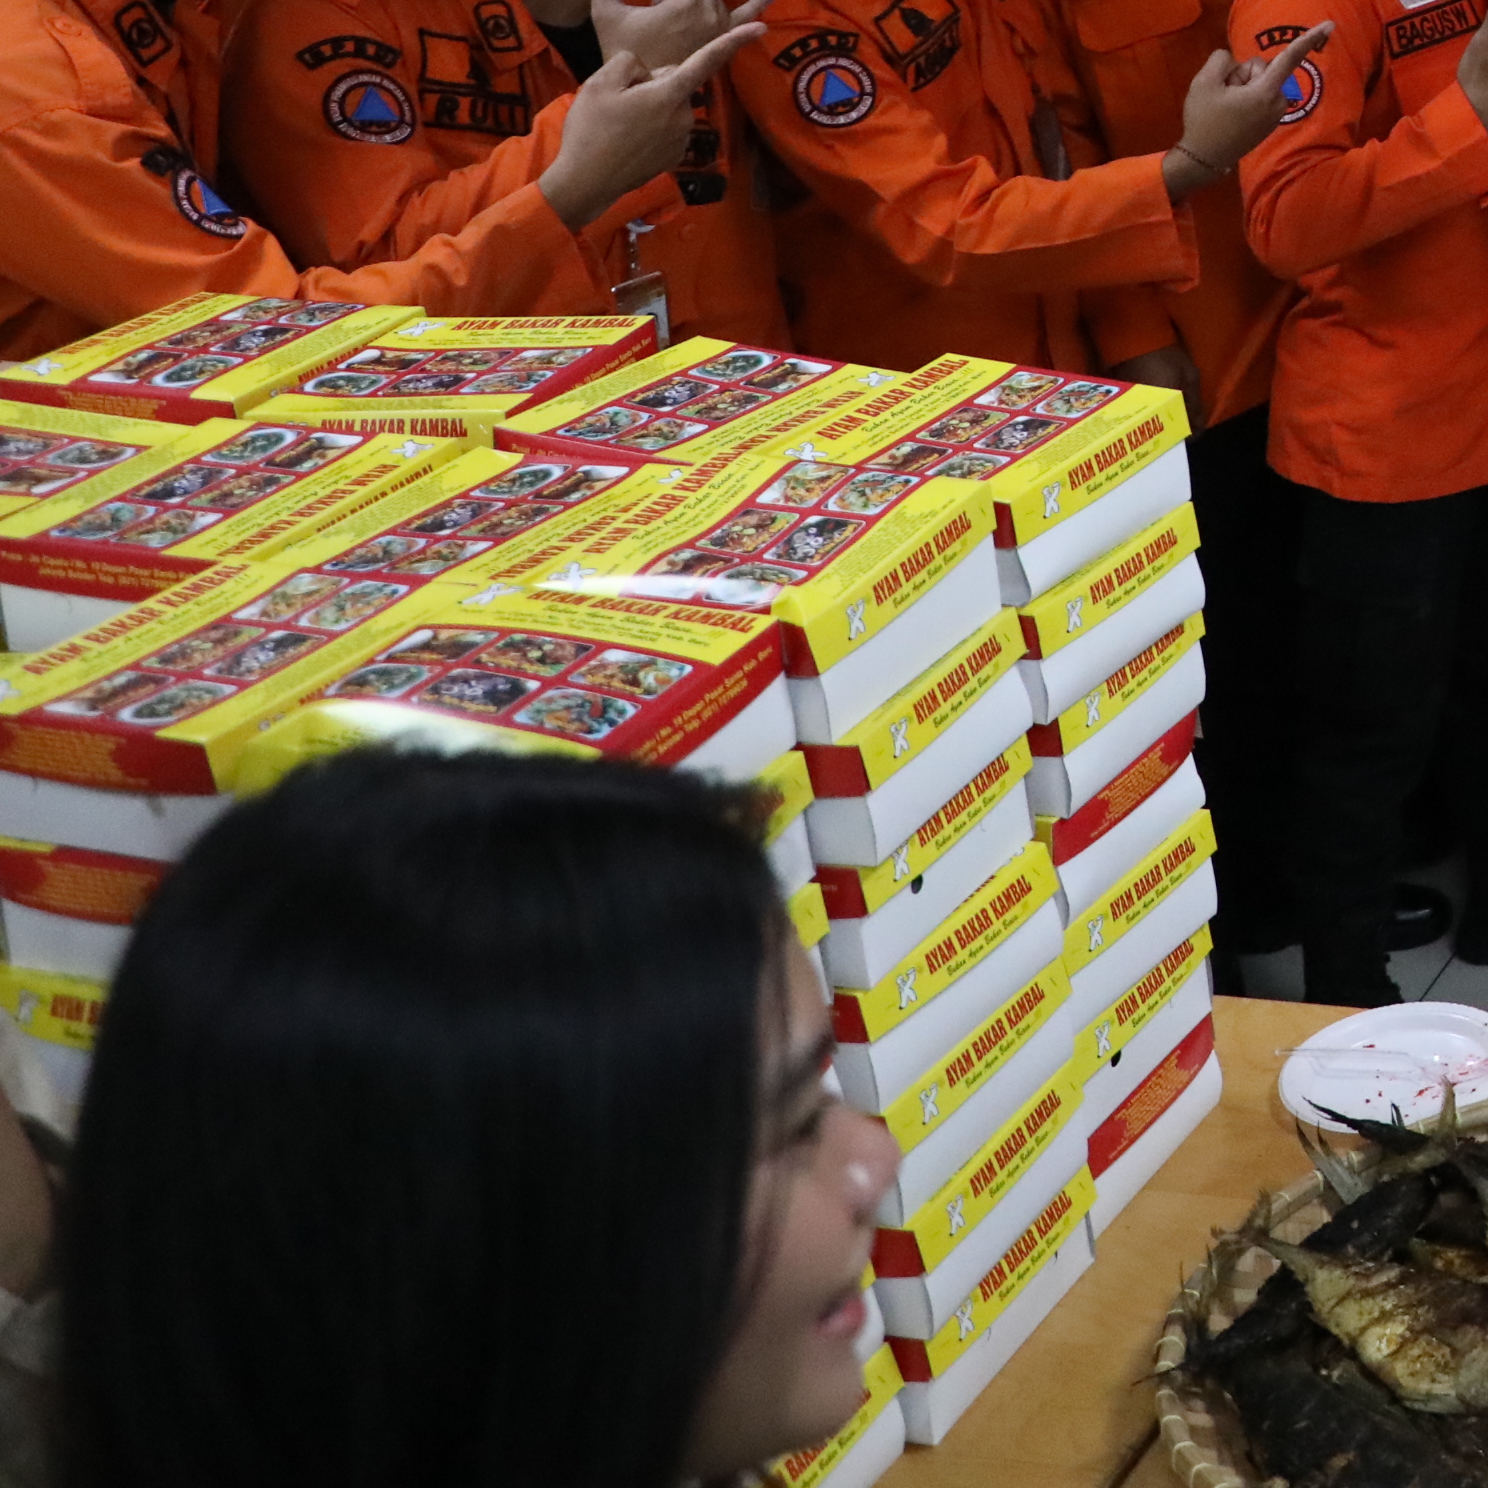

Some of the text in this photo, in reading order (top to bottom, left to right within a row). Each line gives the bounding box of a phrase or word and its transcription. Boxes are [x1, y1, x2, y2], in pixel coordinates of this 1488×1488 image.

[1396, 10, 1456, 48] BAGUS
[451, 317, 638, 330] AYAM BAKAR KAMBAL
[360, 419, 407, 435] BAKAR
[410, 418, 467, 437] KAMBAL
[815, 359, 970, 440] AYAM BAKAR KAMBAL
[1067, 414, 1165, 491] AYAM BAKAR KAMBAL
[582, 452, 741, 553] AYAM BAKAR KAMBAL
[872, 510, 972, 605] AYAM BAKAR KAMBAL
[1089, 528, 1178, 604] AYAM BAKAR KAMBAL
[22, 564, 251, 676] AYAM BAKAR KAMBAL
[527, 589, 758, 633] AYAM BAKAR KAMBAL
[912, 634, 1002, 724] AYAM BAKAR KAMBAL
[915, 753, 1010, 848] AYAM BAKAR KAMBAL
[1109, 836, 1196, 922] AYAM BAKAR KAMBAL
[924, 874, 1033, 975] AYAM BAKAR KAMBAL
[1114, 938, 1195, 1026] AYAM BAKAR KAMBAL
[945, 982, 1045, 1089] AYAM BAKAR KAMBAL
[969, 1089, 1062, 1198] AYAM BAKAR KAMBAL
[977, 1190, 1073, 1303] AYAM BAKAR KAMBAL
